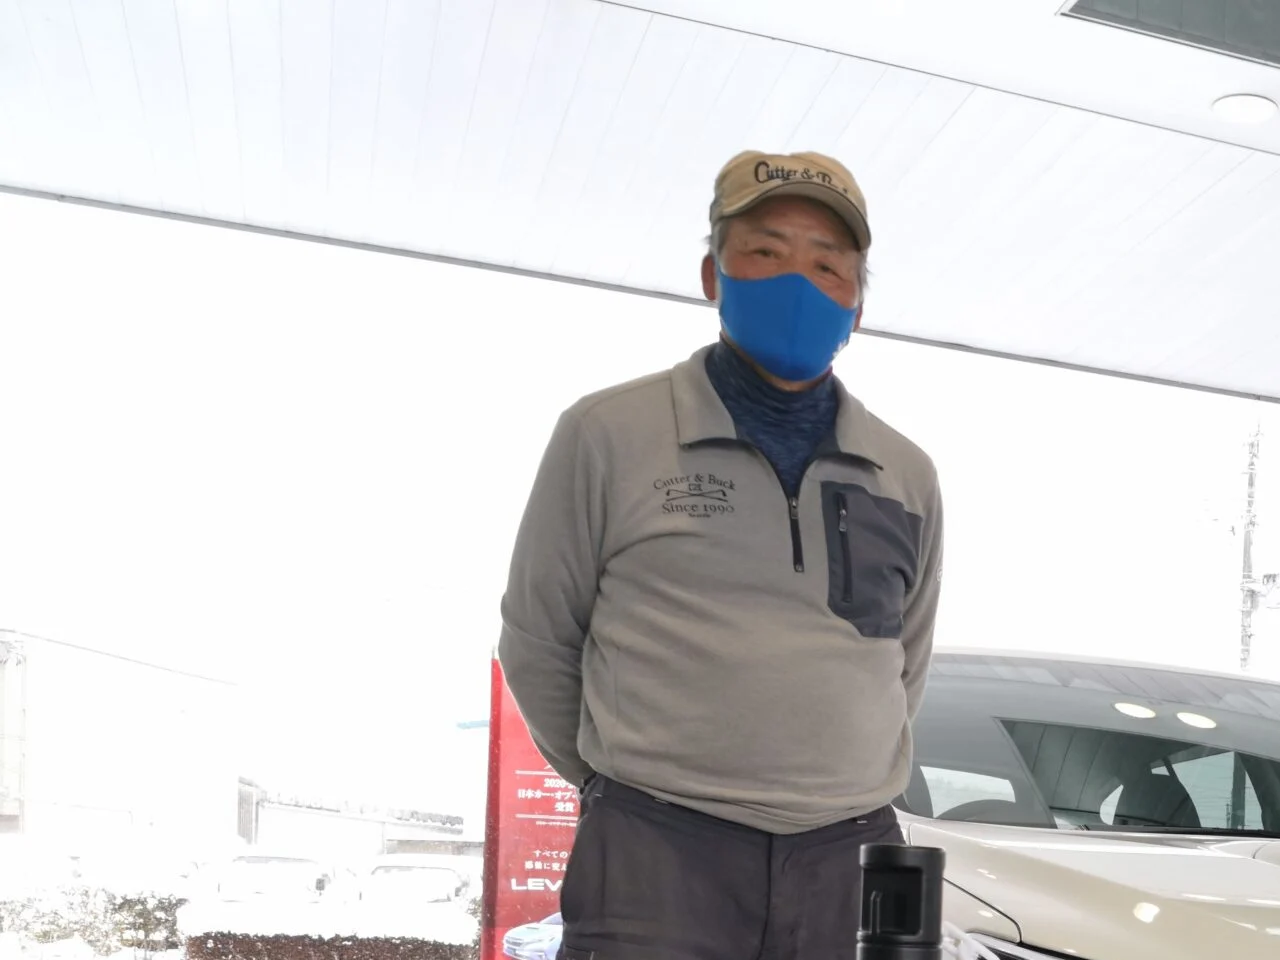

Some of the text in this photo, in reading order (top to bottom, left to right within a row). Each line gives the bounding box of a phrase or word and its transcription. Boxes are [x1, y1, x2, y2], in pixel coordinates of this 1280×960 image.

[800, 168, 815, 180] &
[653, 475, 690, 490] Cutter
[694, 473, 704, 483] &
[708, 473, 737, 491] Buck
[661, 503, 735, 514] Since 1990
